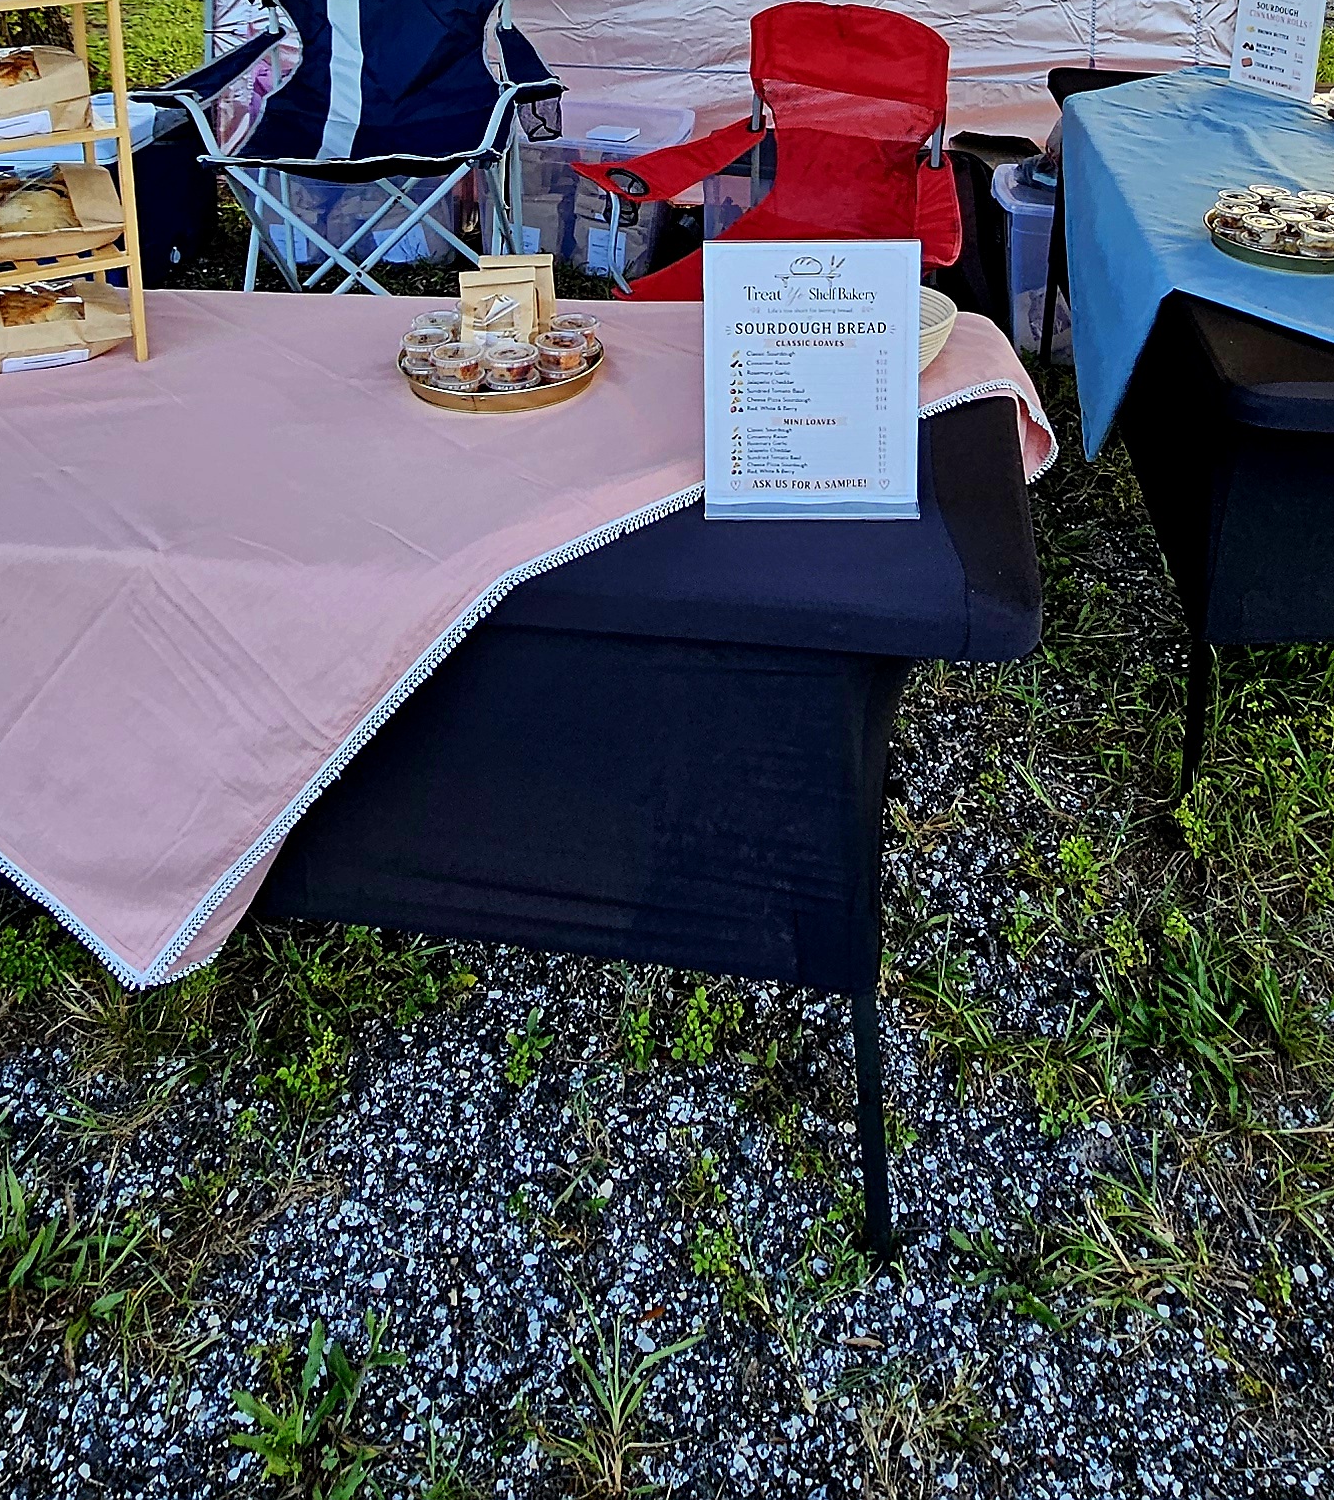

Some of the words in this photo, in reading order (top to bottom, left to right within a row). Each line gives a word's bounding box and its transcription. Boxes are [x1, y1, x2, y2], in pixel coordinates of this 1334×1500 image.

[1257, 1, 1299, 17] SOURDOUGH
[743, 285, 781, 301] Treat
[809, 287, 837, 301] Shelf
[838, 287, 877, 304] Bakery
[735, 322, 832, 335] SOURDOUGH
[837, 322, 888, 335] BREAD
[752, 480, 772, 488] ASK
[775, 479, 788, 488] US
[792, 480, 811, 489] FOR
[814, 480, 821, 489] A
[824, 478, 867, 488] SAMPLE!
